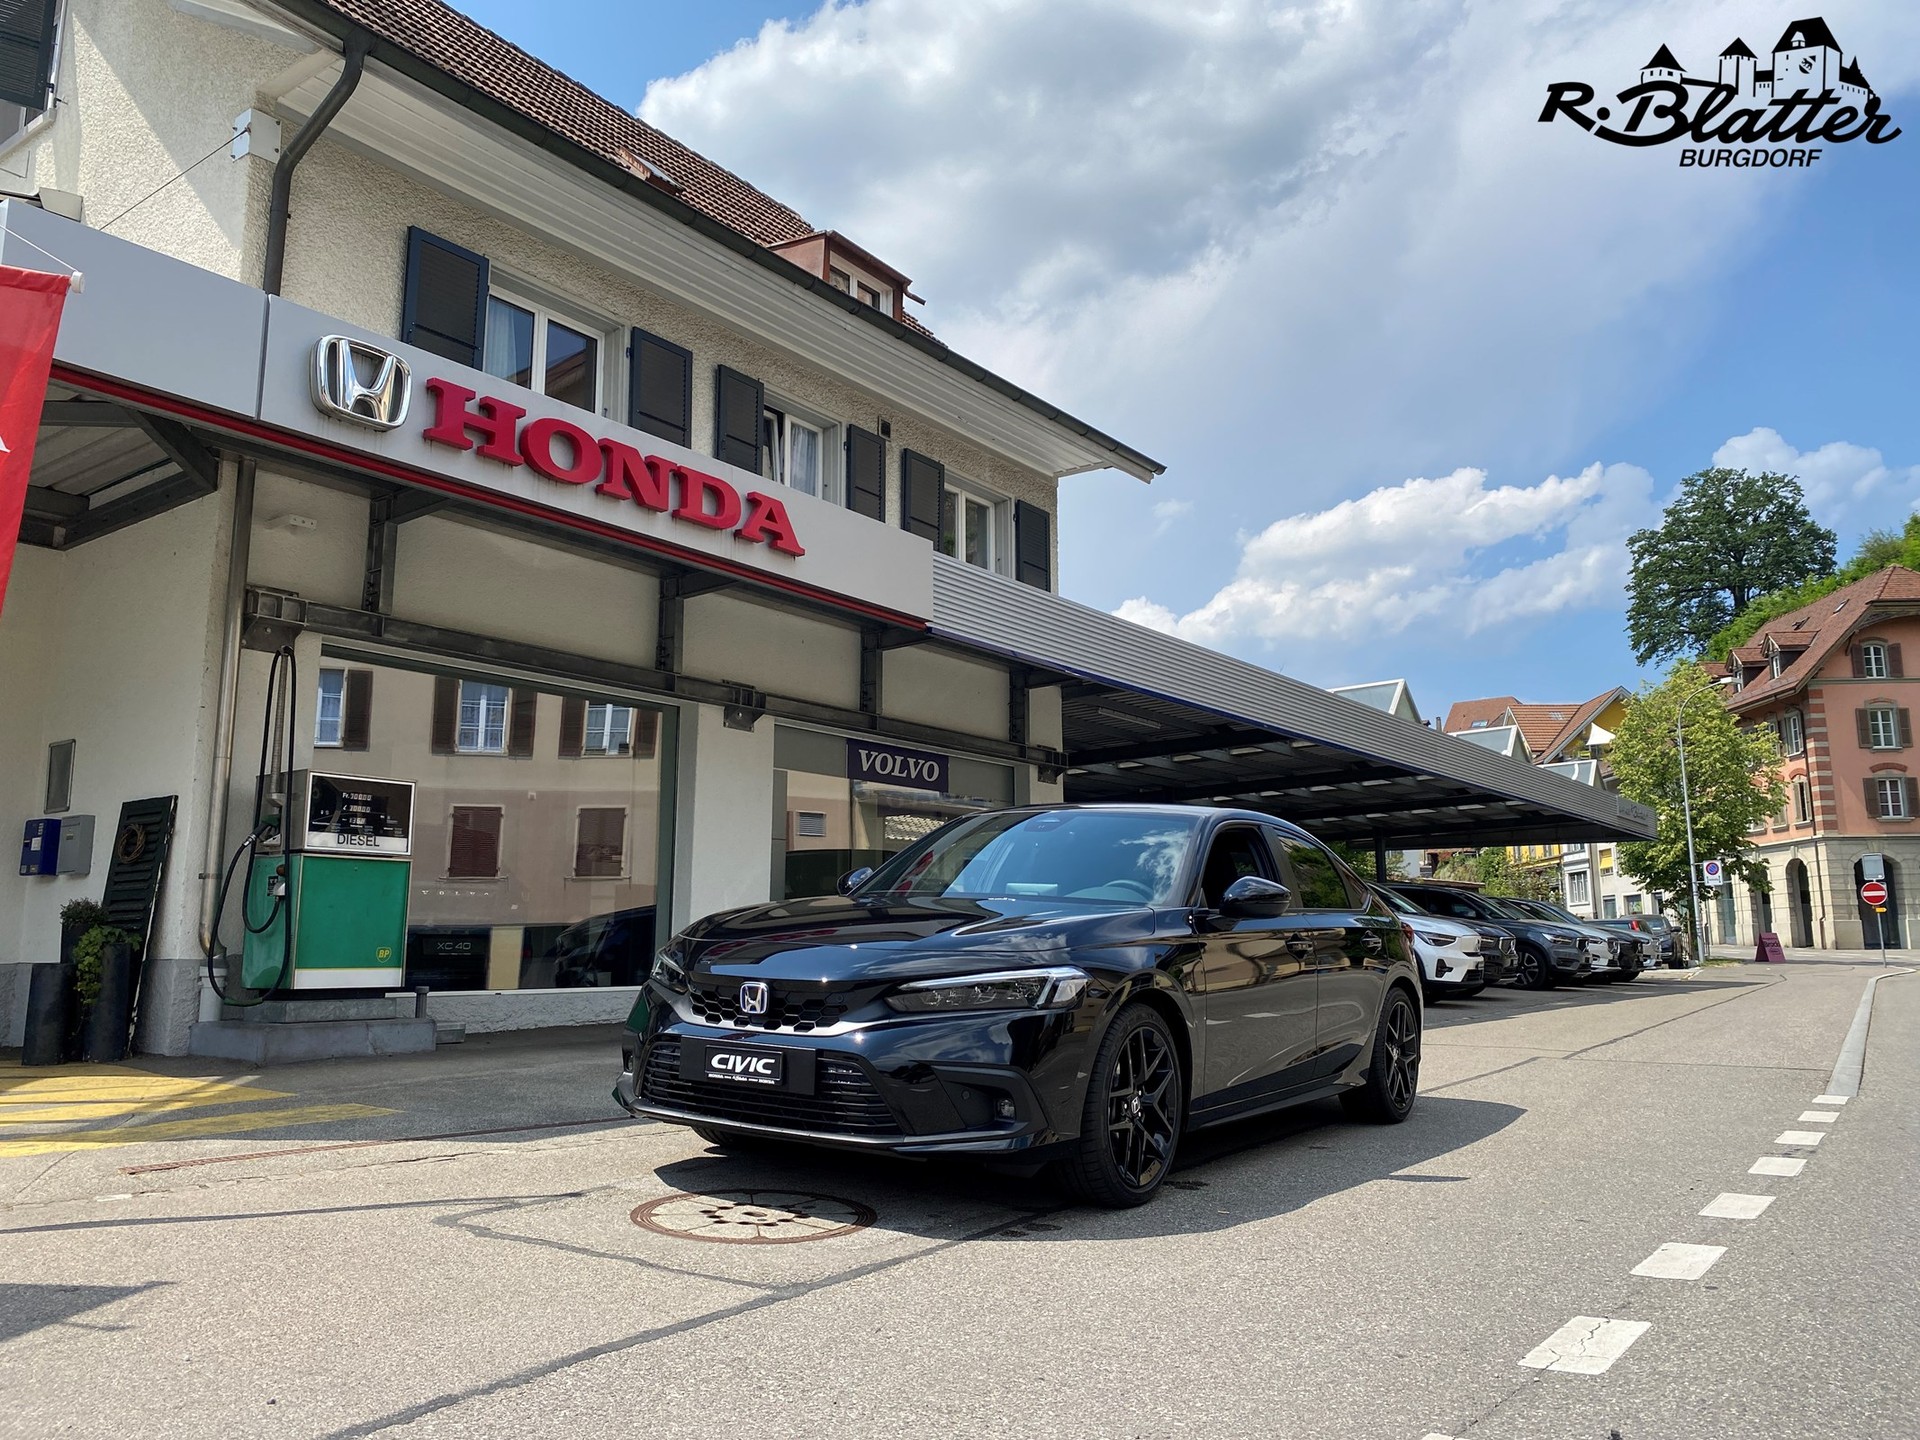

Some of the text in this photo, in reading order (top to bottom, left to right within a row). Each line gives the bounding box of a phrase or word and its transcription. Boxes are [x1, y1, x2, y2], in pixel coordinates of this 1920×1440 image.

[423, 376, 806, 558] HONDA
[858, 749, 940, 782] VOLVO
[337, 834, 380, 847] DIESEL
[378, 949, 390, 958] BP
[711, 1053, 776, 1075] CIVIC
